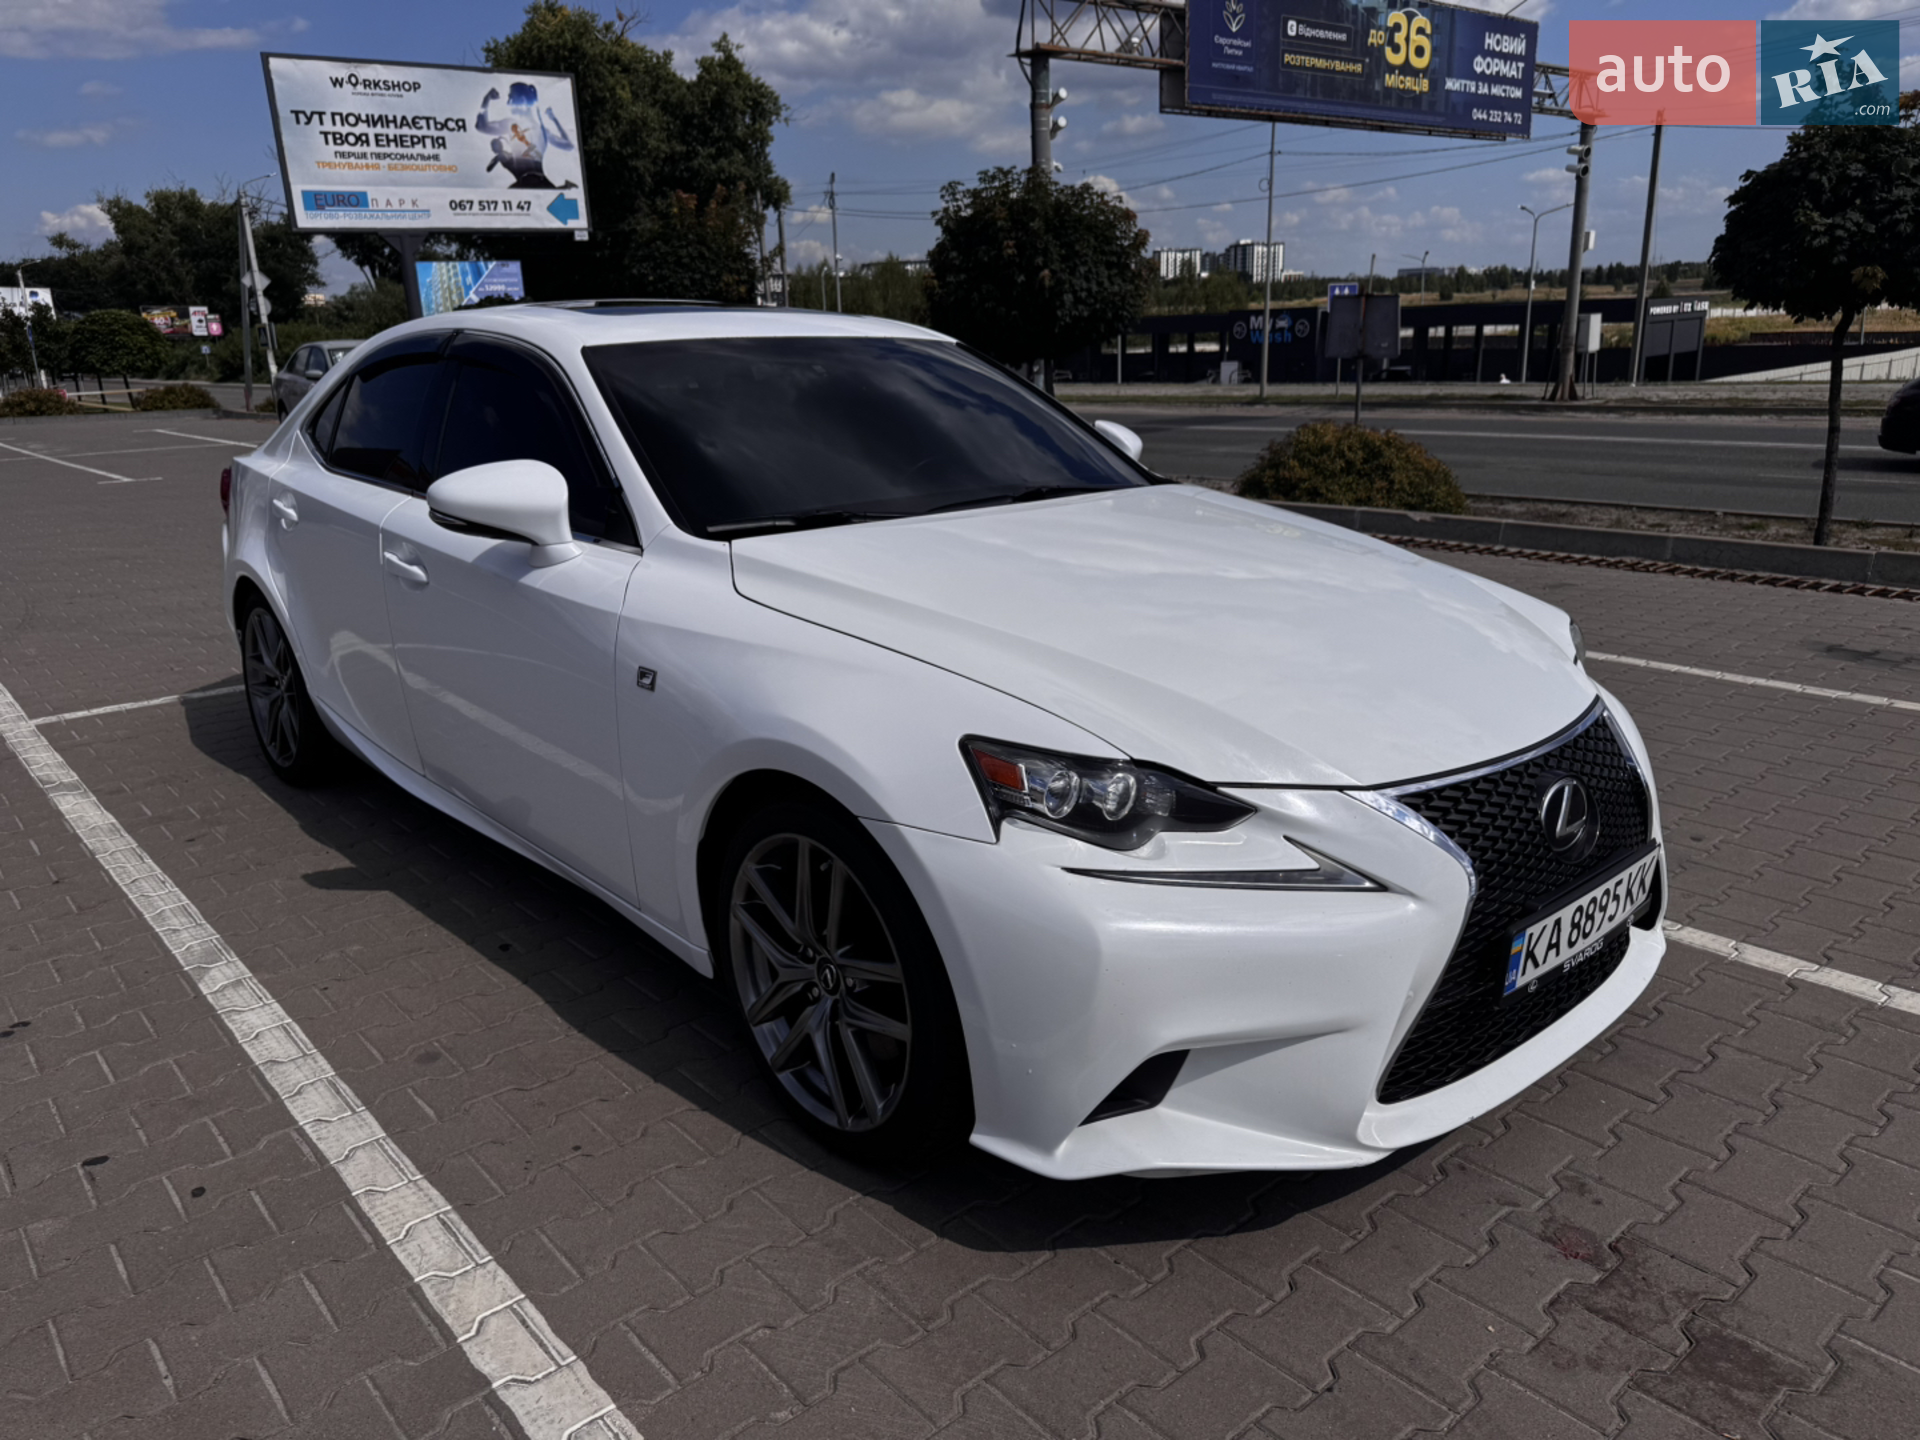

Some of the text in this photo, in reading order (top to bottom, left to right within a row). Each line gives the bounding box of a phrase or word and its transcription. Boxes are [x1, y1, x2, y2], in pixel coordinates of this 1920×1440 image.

[1298, 24, 1347, 42] Відновлення
[1385, 11, 1432, 69] 36
[1484, 32, 1527, 56] НОВИЙ
[1284, 53, 1363, 74] РОЗТЕРМІНУВАННЯ
[1473, 55, 1525, 79] ФОРМАТ
[329, 73, 422, 92] WORKSHOP
[1445, 77, 1523, 99] ЖИТТЯ ЗА МІСТОМ
[290, 110, 467, 132] ТУТ ПОЧИНАЄТЬСЯ
[1472, 108, 1523, 125] 044 232 74 72
[319, 131, 447, 150] ТВОЯ ЕНЕРГІЯ
[334, 151, 441, 162] ПЕРШЕ ПЕРСОНАЛЬНЕ
[315, 161, 459, 173] ТРЕНУВАННЯ БЕЗКОШТОВНО
[314, 193, 361, 210] EURO
[449, 200, 532, 212] 067 517 11 47
[1521, 855, 1656, 977] KA 8895 KK
